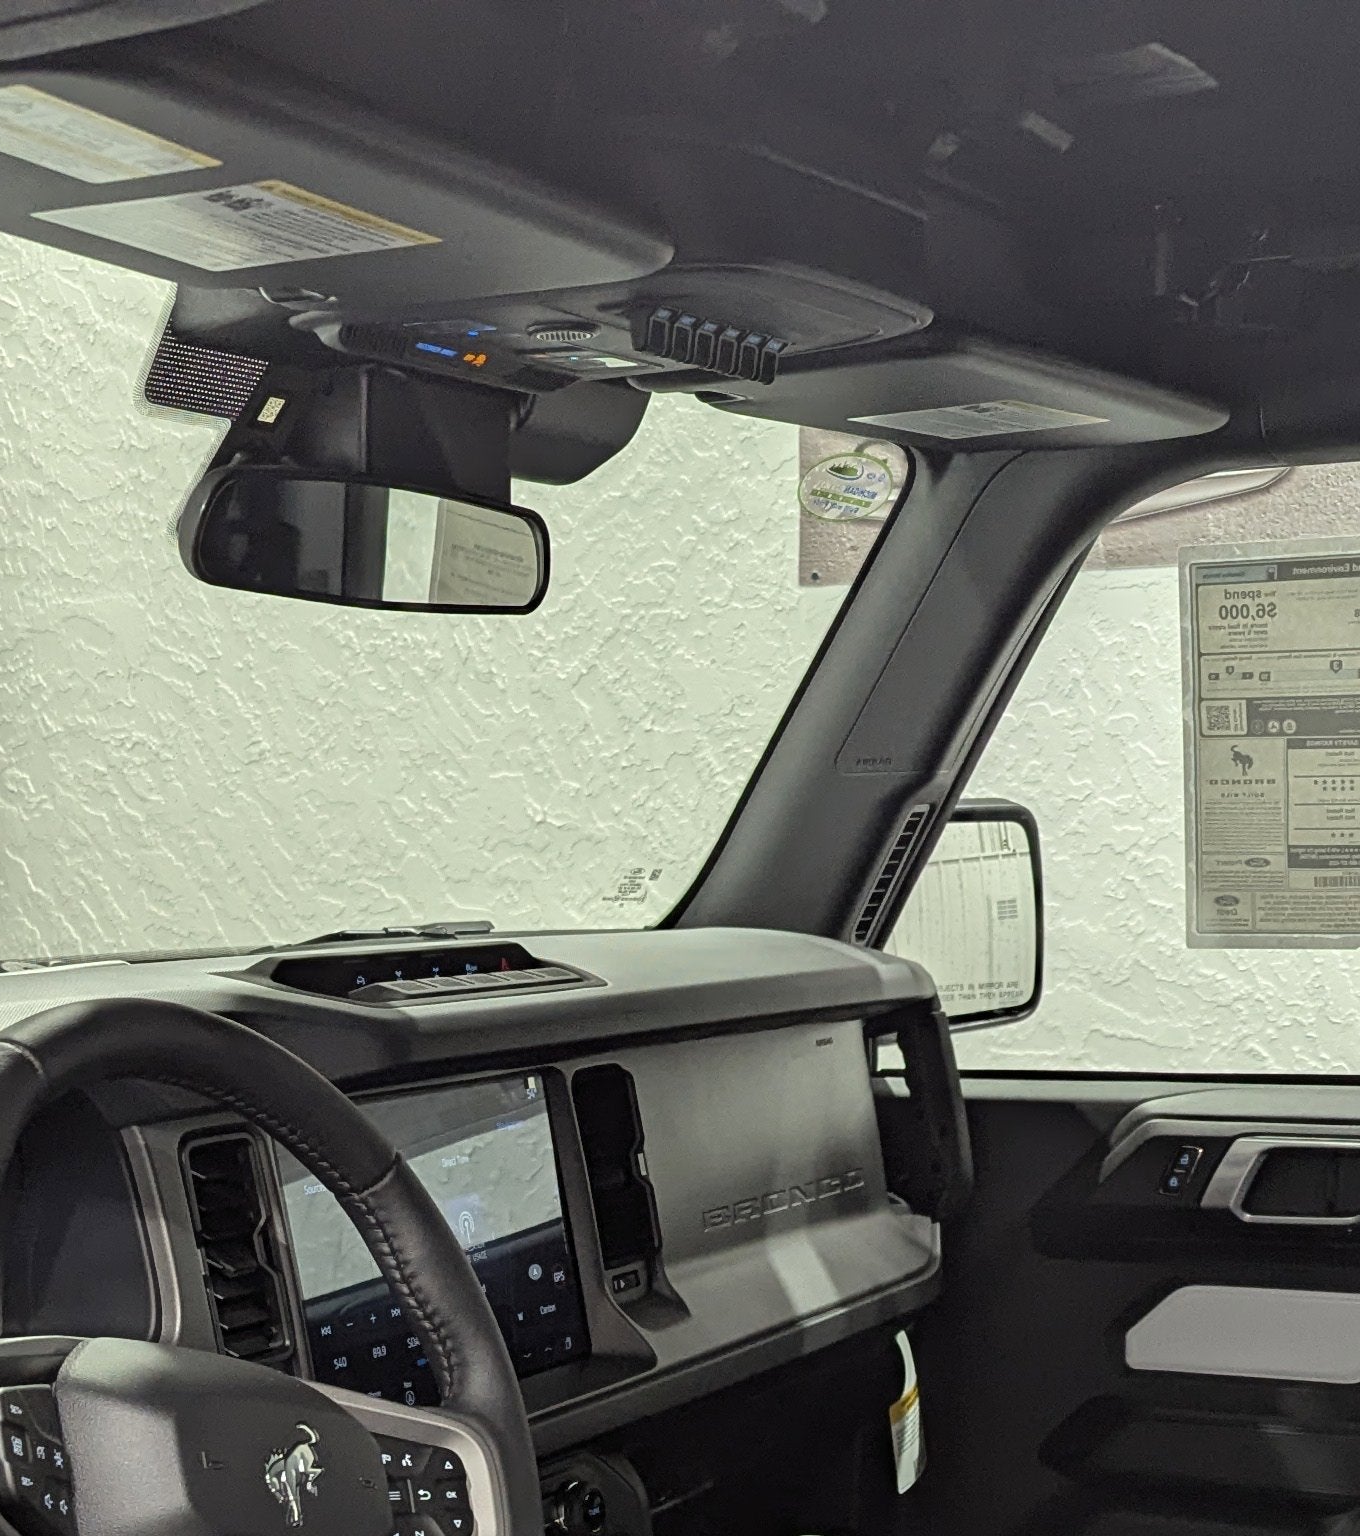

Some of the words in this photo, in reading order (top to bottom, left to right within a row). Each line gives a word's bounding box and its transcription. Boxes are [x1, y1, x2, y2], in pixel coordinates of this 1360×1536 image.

[977, 981, 1004, 991] MIRROR
[702, 1168, 865, 1232] BRONCO
[445, 1490, 458, 1499] OK
